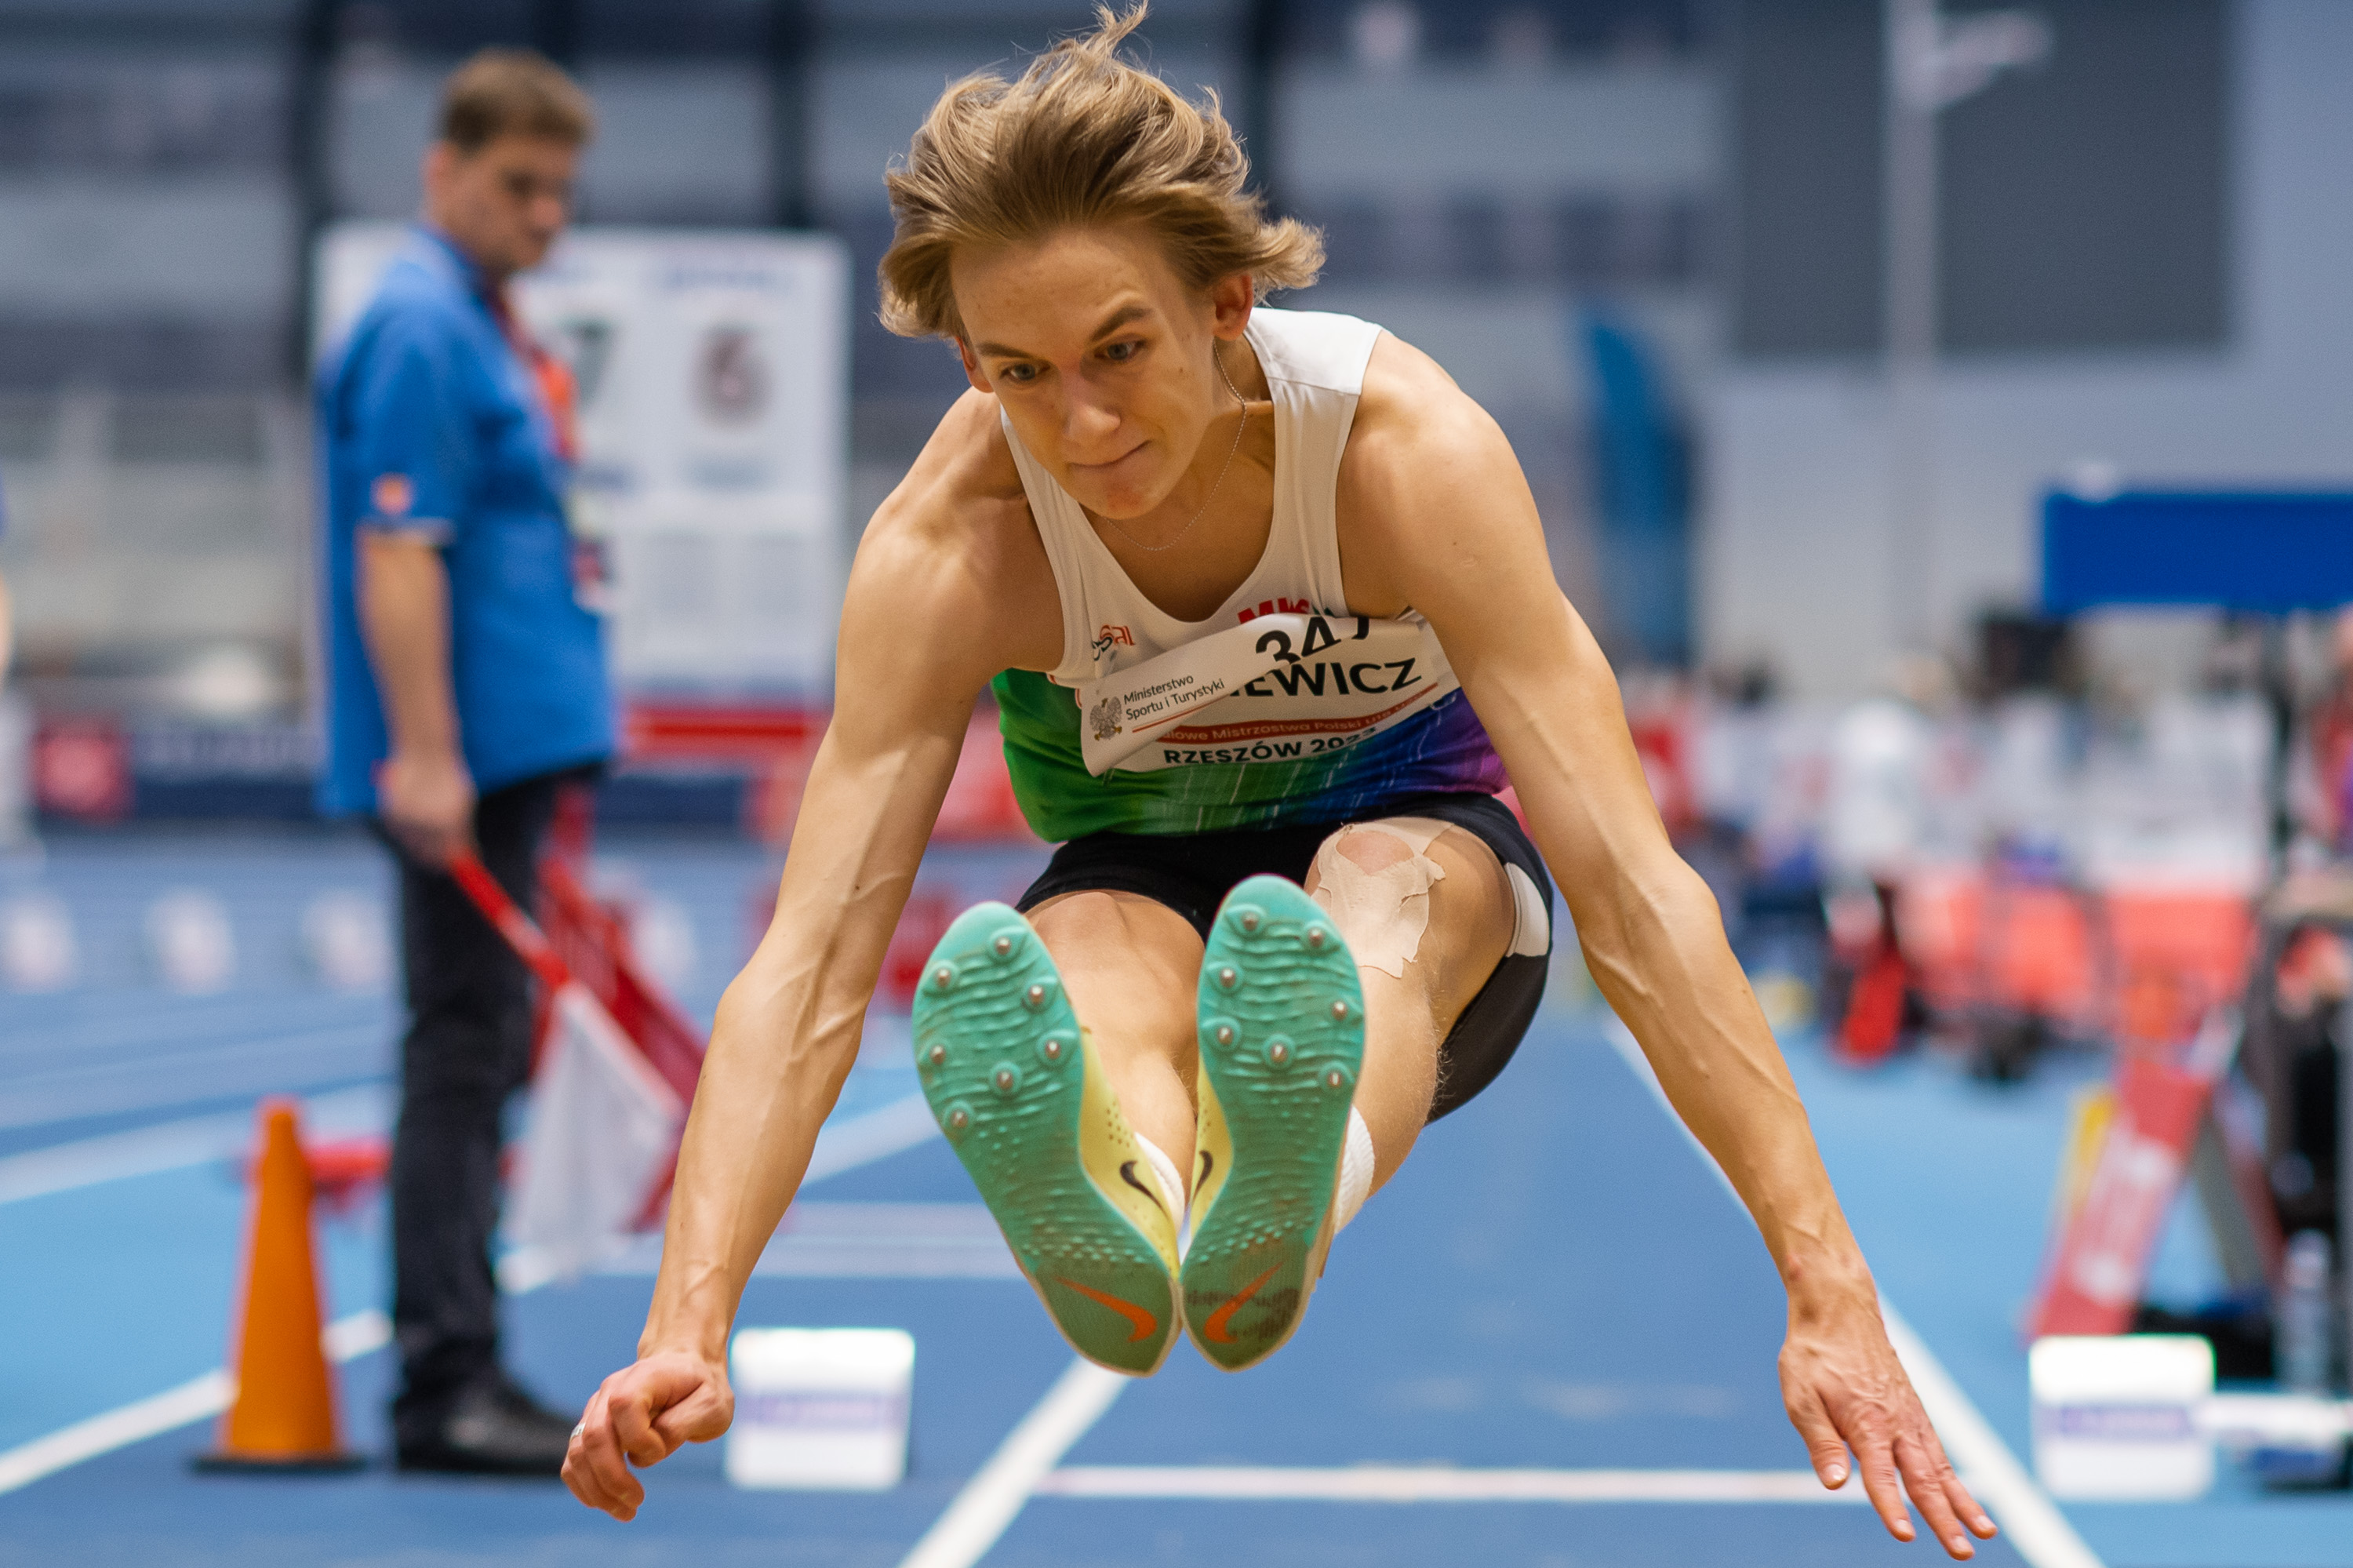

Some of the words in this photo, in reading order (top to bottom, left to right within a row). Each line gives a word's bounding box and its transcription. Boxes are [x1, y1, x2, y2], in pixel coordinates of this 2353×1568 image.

[1123, 675, 1195, 705] Ministerstwo
[1230, 657, 1422, 697] EWICZ
[1126, 700, 1164, 721] Sportu
[1165, 697, 1170, 708] i
[1170, 678, 1225, 706] Turystyki
[1212, 721, 1311, 740] Mistrzostwa
[1315, 719, 1362, 730] Polski
[1163, 740, 1302, 765] RZESZÓW
